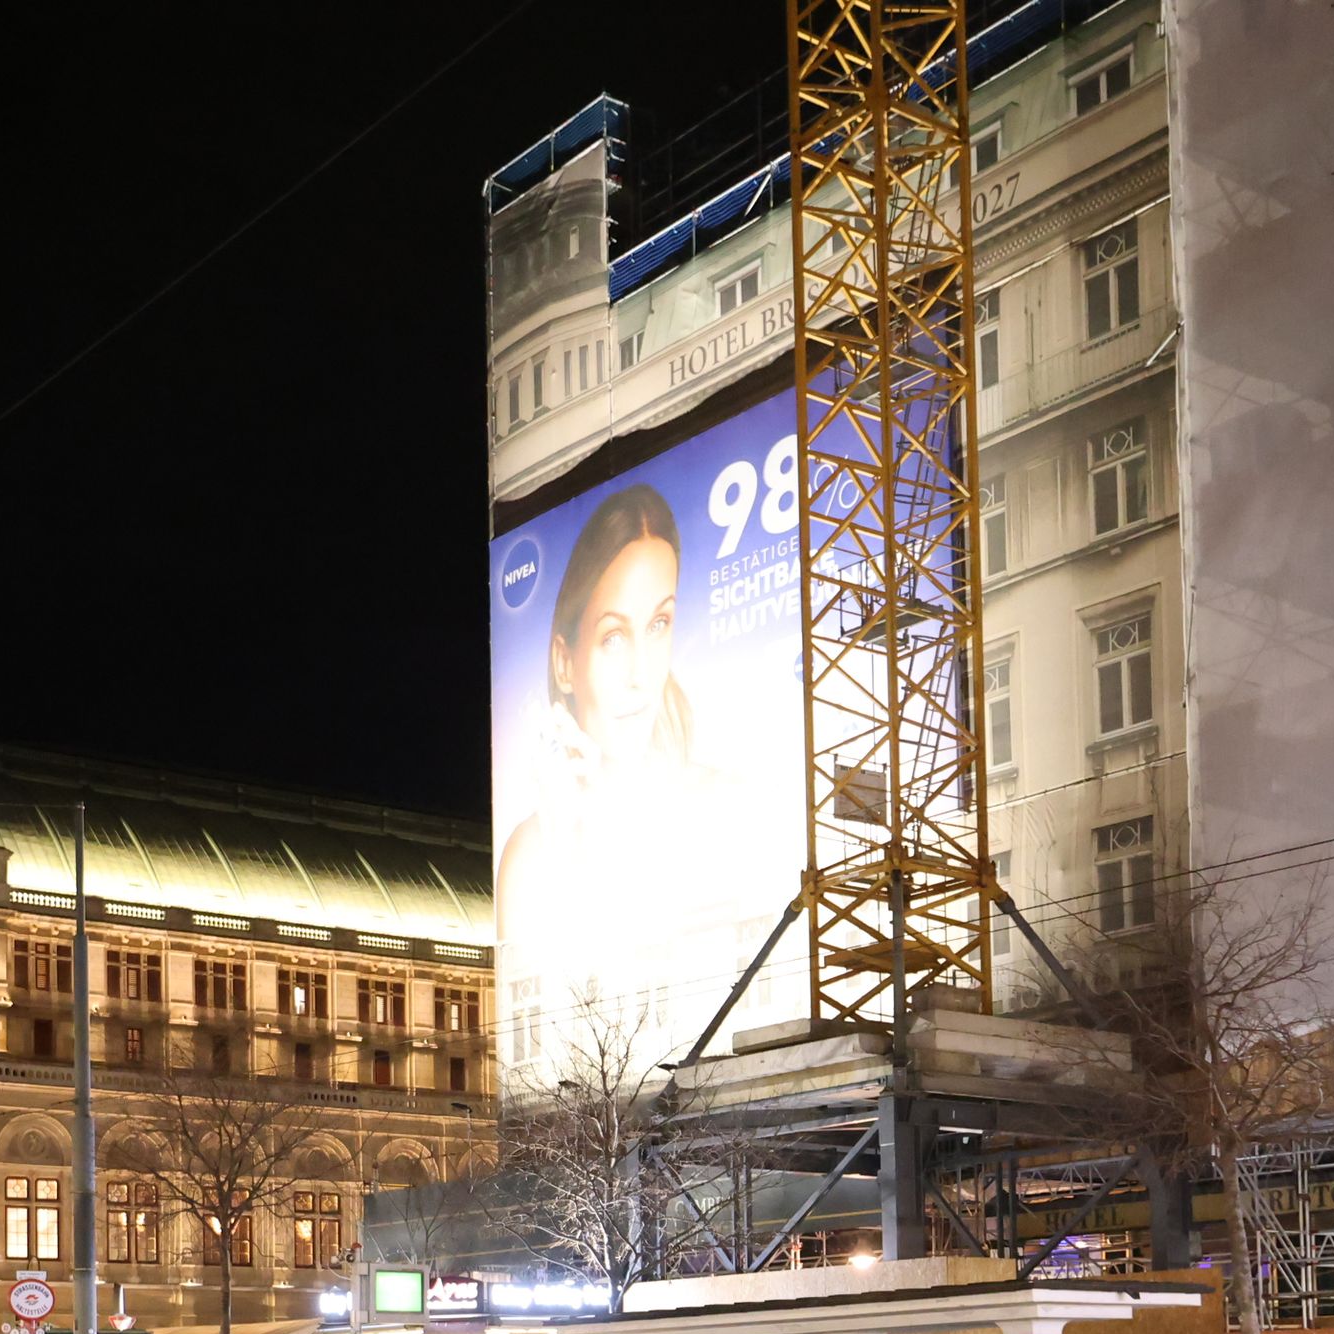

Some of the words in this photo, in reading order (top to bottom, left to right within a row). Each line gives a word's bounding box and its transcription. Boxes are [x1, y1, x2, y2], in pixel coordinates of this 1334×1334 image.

[669, 321, 754, 386] HOTEL
[957, 172, 1020, 234] 027
[505, 561, 536, 587] NIVEA
[710, 536, 798, 586] BESTÄTIGE
[14, 1284, 49, 1298] STRASSENBAHN
[16, 1303, 47, 1316] HALTESTELLE
